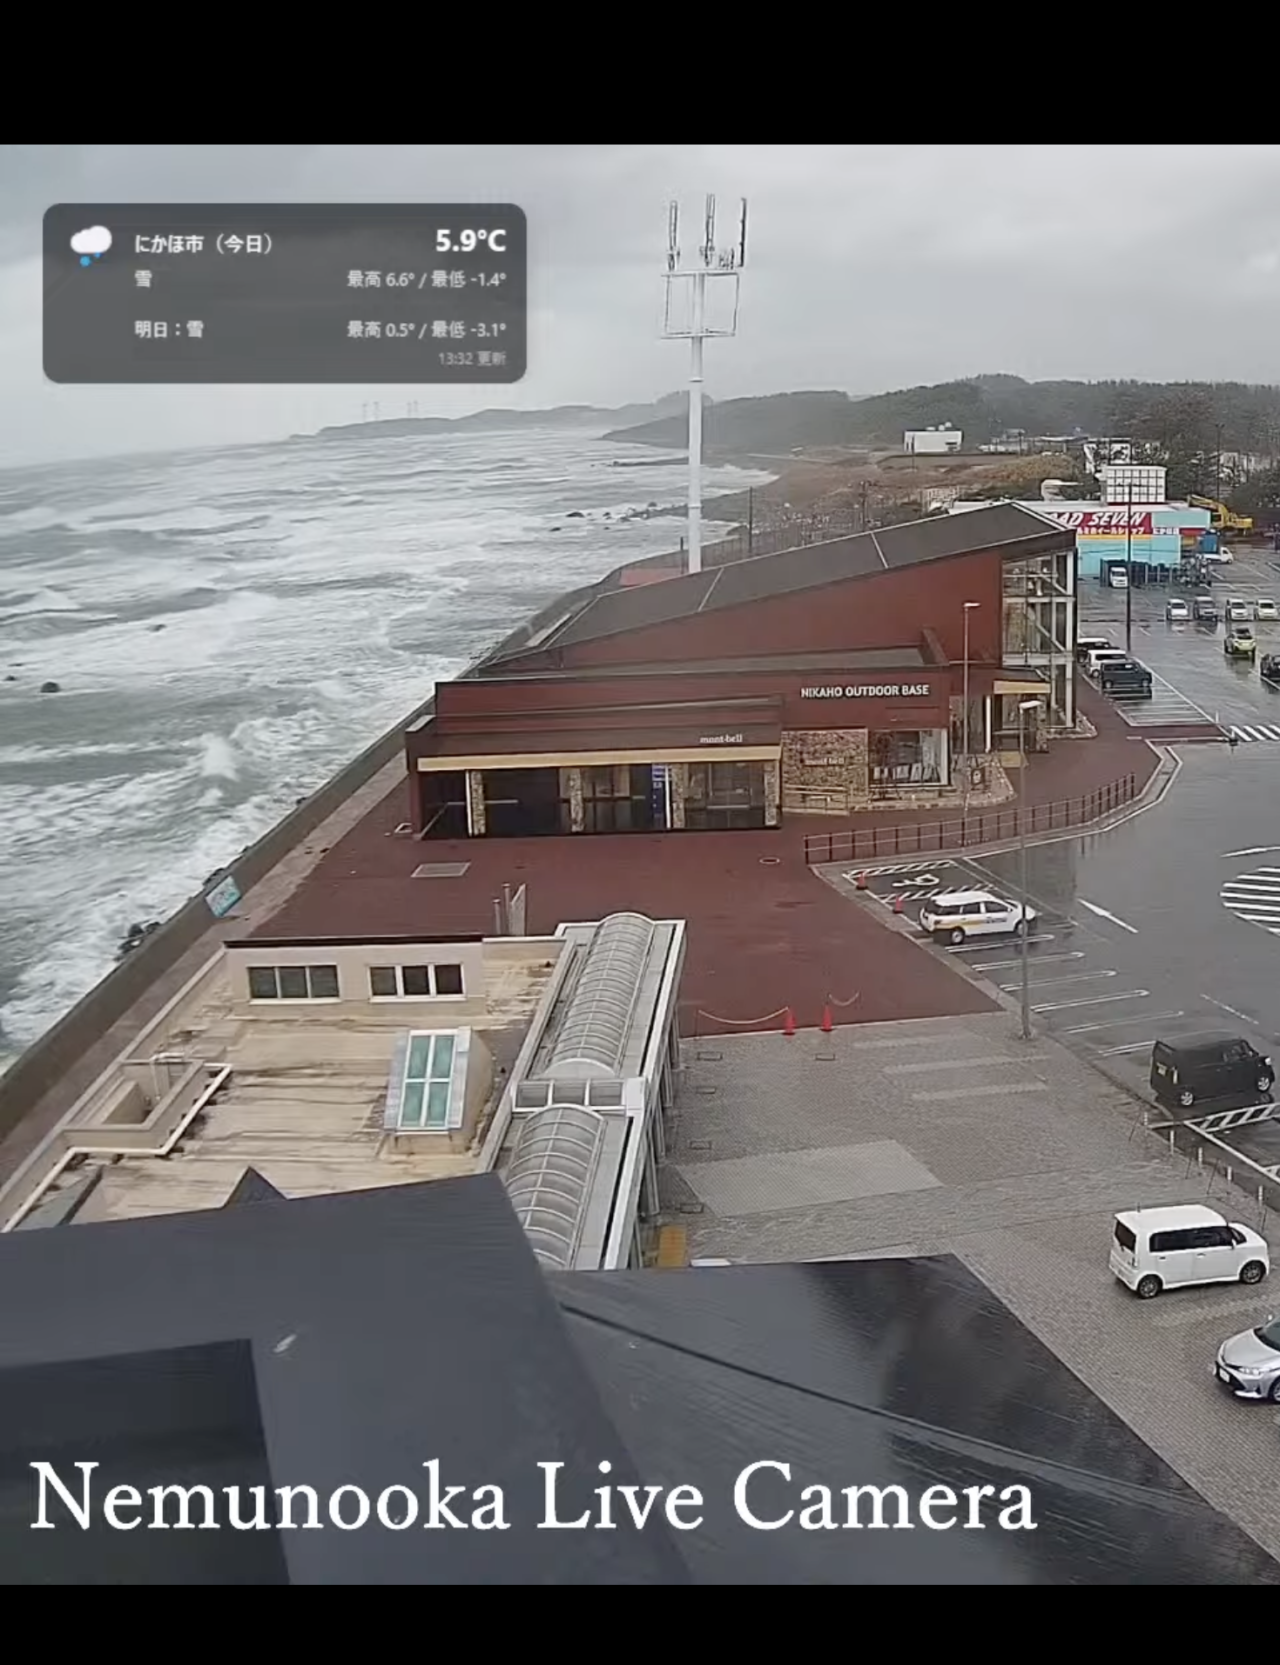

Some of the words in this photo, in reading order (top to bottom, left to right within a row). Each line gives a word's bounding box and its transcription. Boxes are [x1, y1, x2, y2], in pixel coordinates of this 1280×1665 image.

[1087, 511, 1146, 526] SEVEN
[801, 686, 844, 698] NIKAHO
[845, 685, 900, 697] OUTDOOR
[902, 684, 930, 696] BASE
